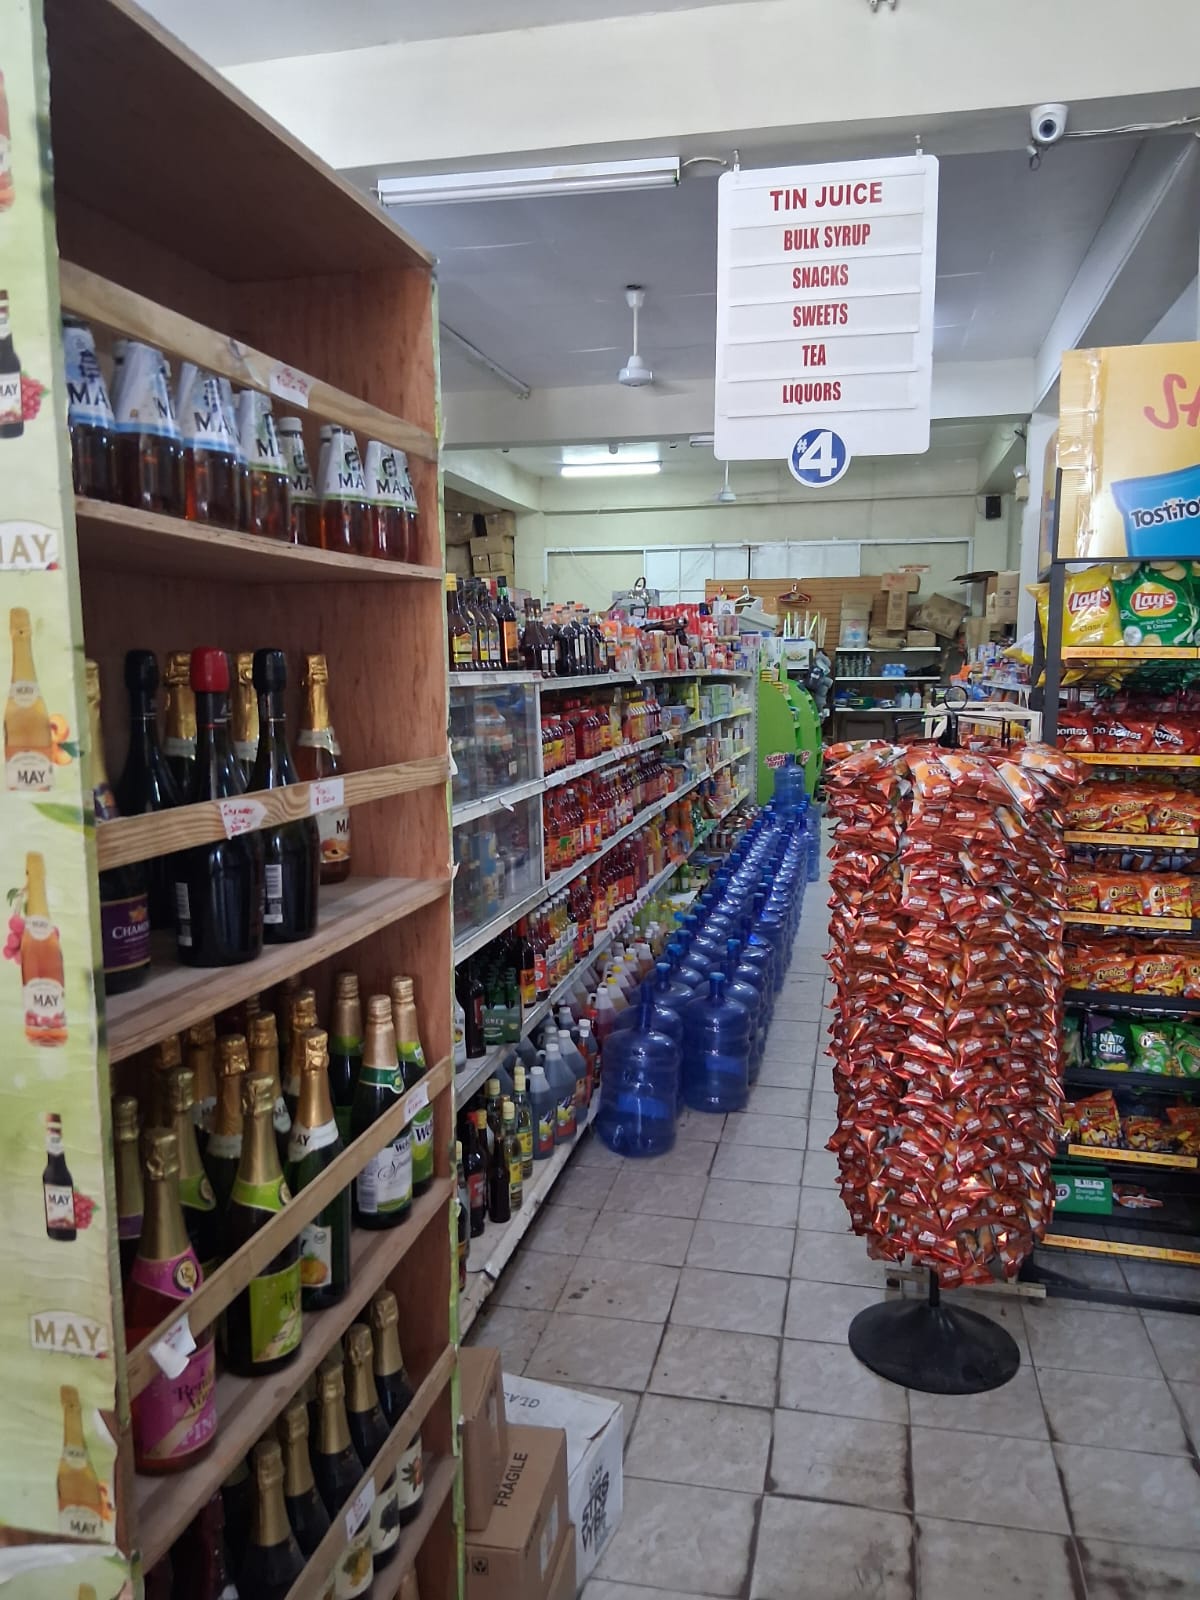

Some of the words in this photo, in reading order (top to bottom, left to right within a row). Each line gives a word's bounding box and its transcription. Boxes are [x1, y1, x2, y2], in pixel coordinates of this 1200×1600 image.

[769, 187, 807, 211] TIN
[814, 182, 883, 208] JUICE
[783, 228, 820, 251] BULK
[824, 223, 871, 248] SYRUP
[792, 264, 849, 289] SNACKS
[792, 303, 848, 327] SWEETS
[802, 344, 826, 367] TEA
[782, 382, 841, 405] LIQUORS
[795, 431, 838, 477] #4
[1131, 499, 1200, 528] TOSTITO
[0, 534, 52, 563] AY
[1071, 586, 1109, 611] Lay's
[1135, 592, 1174, 610] Lay's
[18, 769, 46, 785] MAY
[33, 993, 59, 1007] MAY
[1099, 1031, 1125, 1043] NATU
[48, 1193, 71, 1206] MAY
[34, 1319, 101, 1351] MAY
[494, 1451, 529, 1508] FRAGILE
[70, 1520, 97, 1536] MAY
